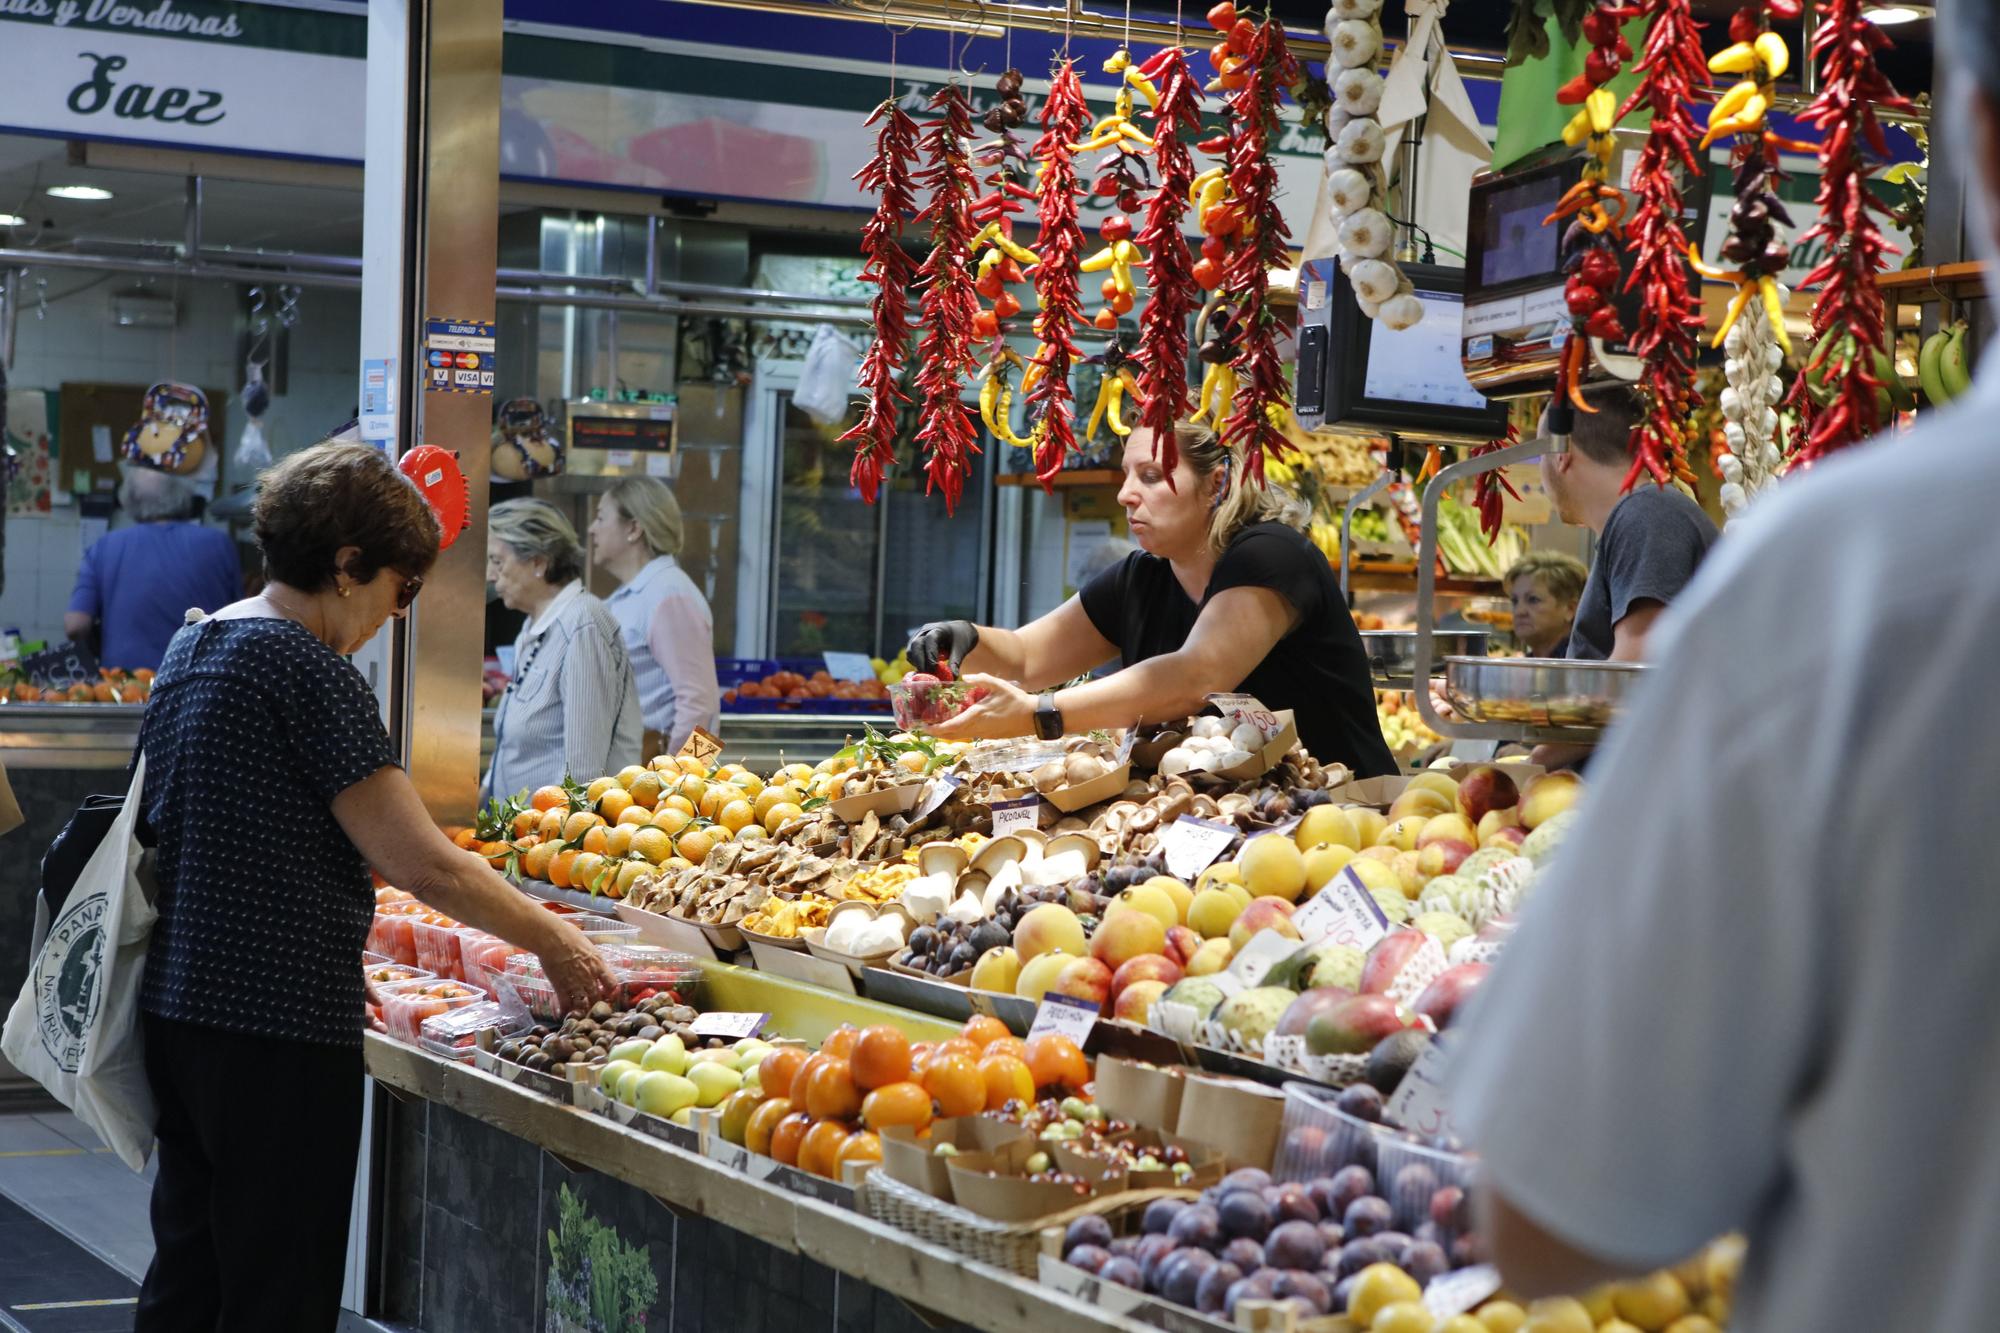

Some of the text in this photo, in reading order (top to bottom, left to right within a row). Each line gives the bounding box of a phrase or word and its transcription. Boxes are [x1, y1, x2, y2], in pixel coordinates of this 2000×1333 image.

[66, 52, 226, 126] Saez
[457, 373, 478, 382] VISA
[483, 375, 495, 383] VI
